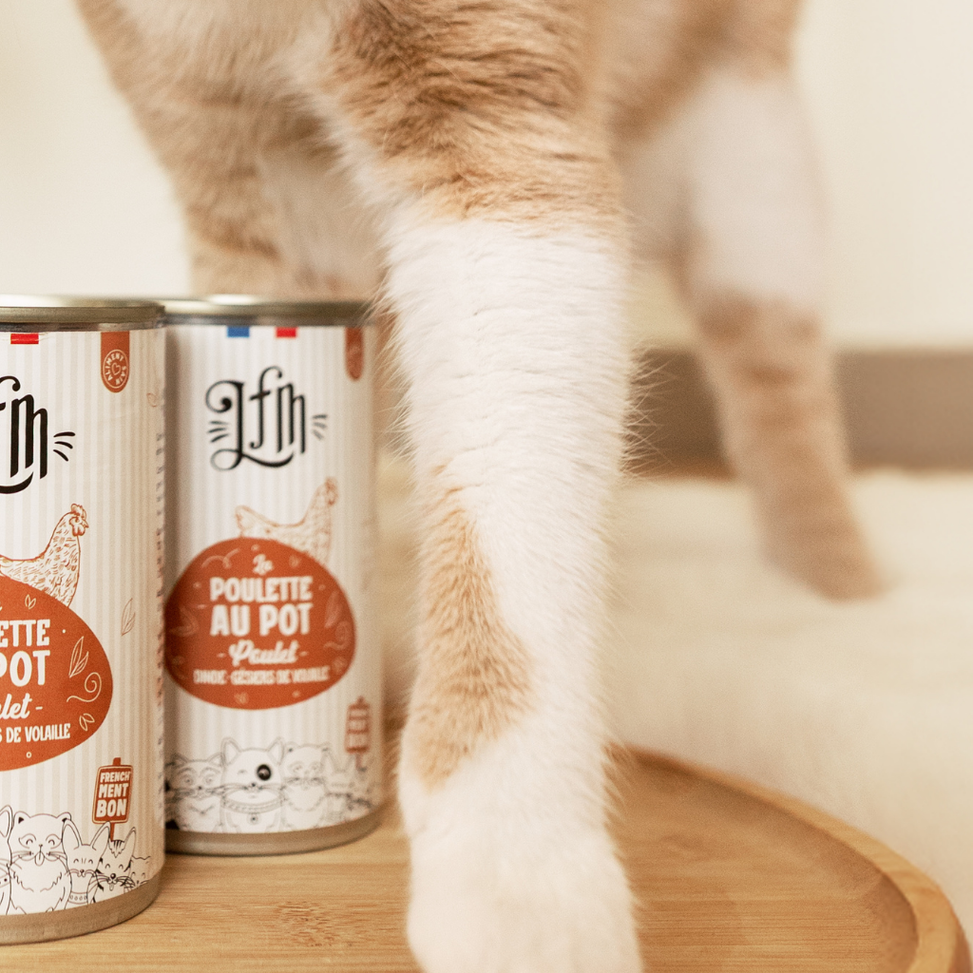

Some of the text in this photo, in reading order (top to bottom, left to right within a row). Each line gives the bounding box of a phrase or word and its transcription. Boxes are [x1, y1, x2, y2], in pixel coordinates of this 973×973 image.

[106, 353, 124, 381] ALIMENT
[209, 576, 313, 602] POULETTE
[210, 603, 313, 636] AU POT
[228, 639, 299, 667] Poulet
[6, 726, 21, 744] DE
[24, 723, 71, 742] VOLAILLE
[98, 783, 129, 798] MENT
[96, 799, 127, 818] BON
